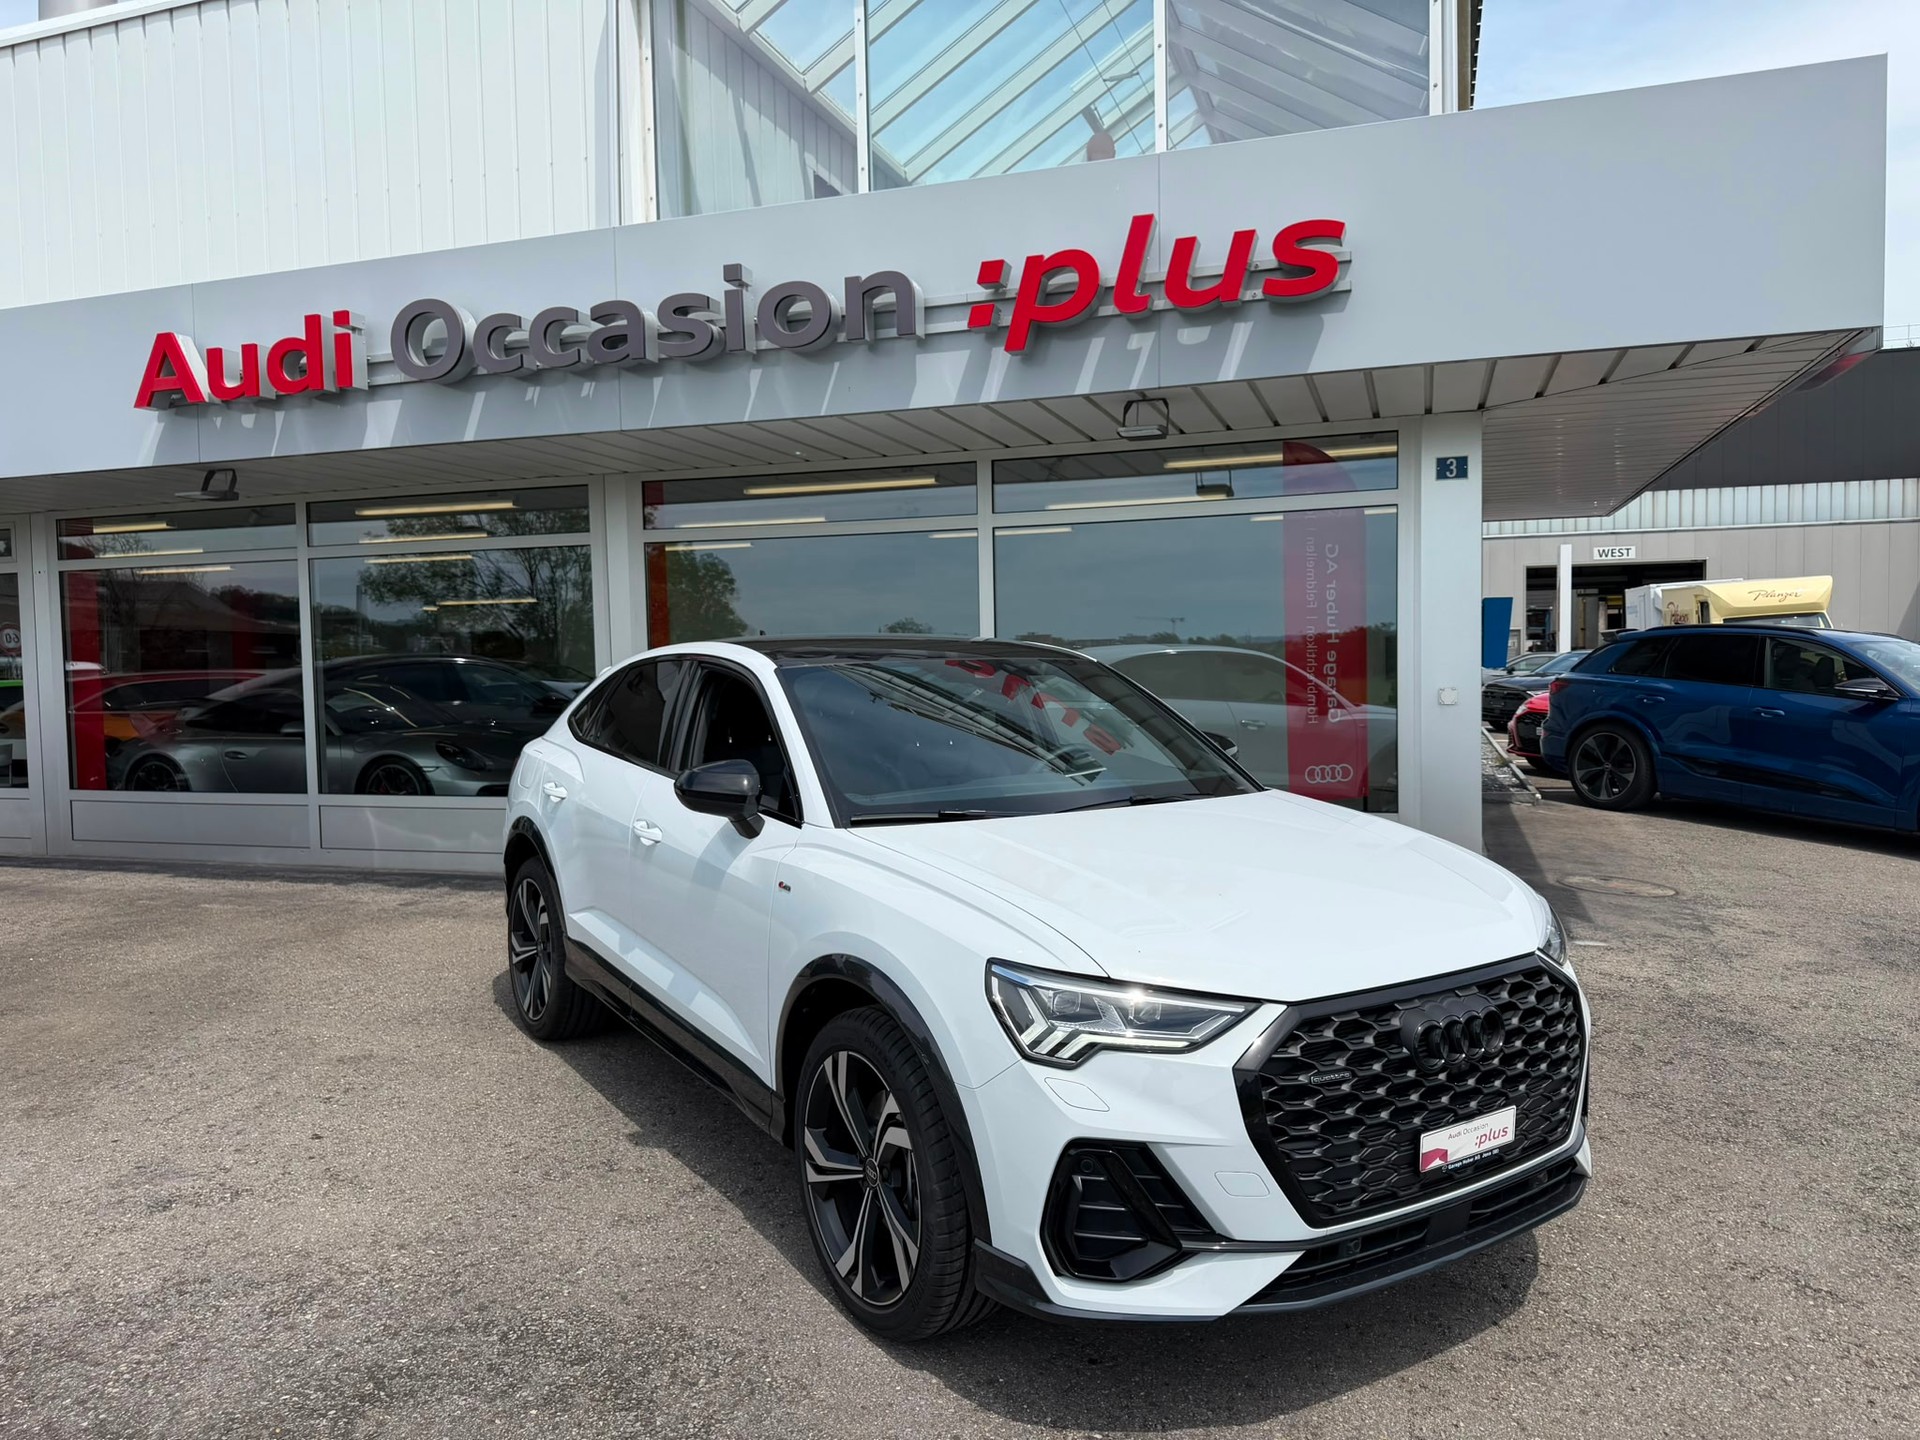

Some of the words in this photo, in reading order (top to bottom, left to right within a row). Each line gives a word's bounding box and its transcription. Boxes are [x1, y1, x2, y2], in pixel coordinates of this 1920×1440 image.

[135, 309, 360, 410] Audi
[390, 262, 920, 385] Occasion
[967, 213, 1347, 355] :plus
[1446, 458, 1457, 478] 3
[1597, 547, 1632, 558] WEST
[1748, 589, 1802, 603] Planzer
[1313, 1072, 1350, 1084] quattro
[1448, 1130, 1461, 1140] Audi
[1463, 1123, 1489, 1135] Occasion
[1474, 1126, 1509, 1148] :plus
